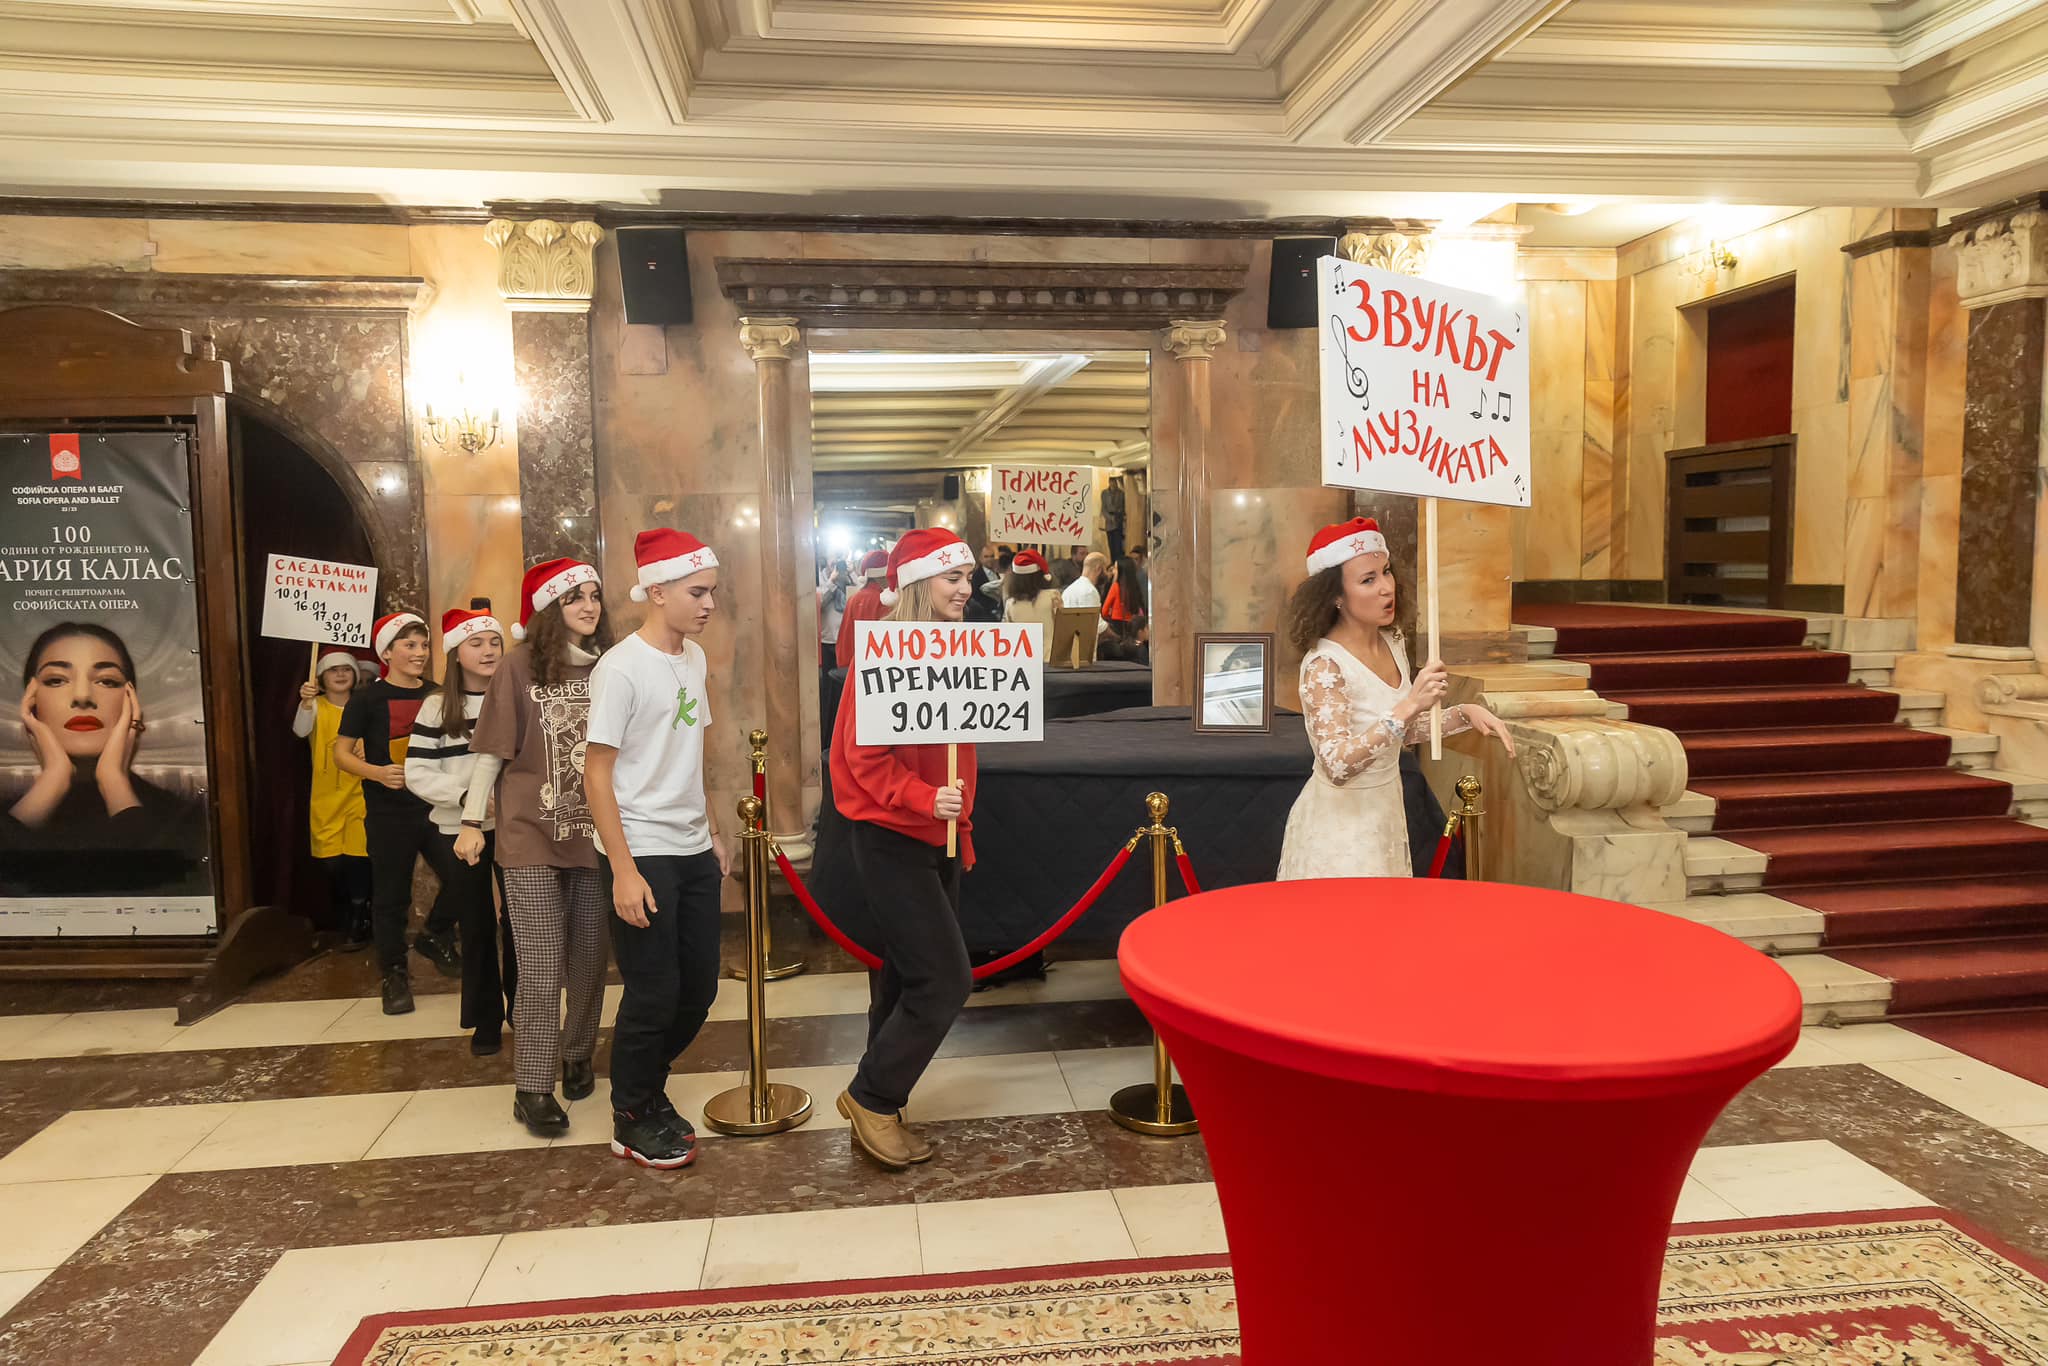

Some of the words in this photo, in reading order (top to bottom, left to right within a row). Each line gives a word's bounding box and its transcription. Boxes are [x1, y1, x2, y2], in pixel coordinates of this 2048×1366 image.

[1346, 278, 1516, 382] ЗВУКЪТ
[1412, 369, 1450, 409] НА
[1352, 408, 1509, 484] МУЗИКАТА
[12, 485, 59, 494] СОФИЙСКА
[61, 486, 88, 494] ОПЕРА
[89, 486, 96, 494] И
[97, 485, 124, 494] БАЛЕТ
[17, 497, 41, 505] SOFIA
[43, 496, 70, 505] OPERA
[71, 496, 89, 504] AND
[90, 496, 120, 504] BALLET
[52, 525, 91, 544] 100
[0, 546, 39, 556] ОДИНИ
[41, 546, 56, 555] ОТ
[59, 545, 132, 555] РОЖДЕНИЕТО
[135, 545, 150, 554] НА
[0, 559, 73, 582] АРИЯ
[80, 557, 182, 581] КАЛАС
[275, 559, 366, 580] СЛЕДВАЩИ
[113, 588, 126, 596] НА
[275, 575, 368, 593] СПЕКТАКЛИ
[13, 599, 97, 611] СОФИЙСКАТА
[99, 599, 139, 610] ОПЕРА
[865, 627, 1034, 661] МЮЗИКЪЛ
[860, 665, 1031, 696] ПРЕМИЕРА
[891, 700, 1030, 733] 9.01.2024
